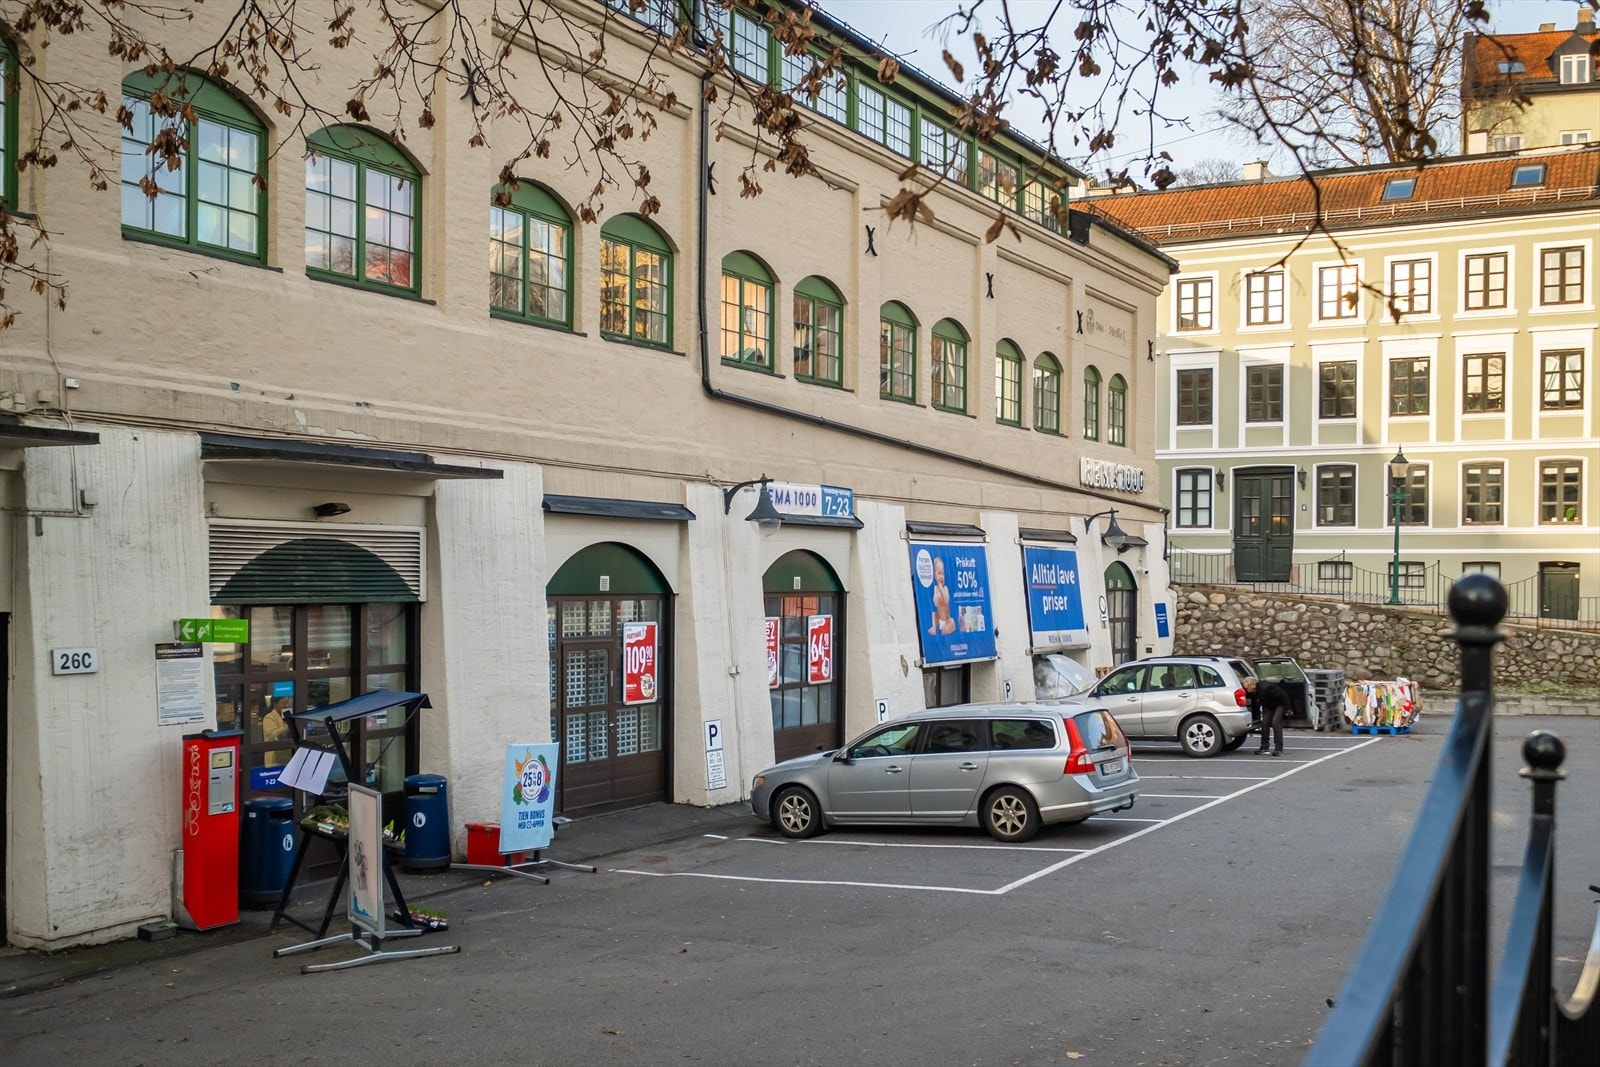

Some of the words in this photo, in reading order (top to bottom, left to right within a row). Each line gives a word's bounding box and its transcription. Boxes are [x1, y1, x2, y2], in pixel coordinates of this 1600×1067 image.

[768, 488, 791, 506] EMA
[794, 491, 817, 506] 1000
[825, 496, 849, 516] 7-23
[955, 557, 976, 567] Priskutt
[957, 571, 978, 589] 50%
[1032, 563, 1056, 584] Alltid
[1057, 565, 1075, 584] lave
[1042, 590, 1068, 615] priser
[811, 633, 825, 662] 64
[60, 652, 92, 670] 26C
[626, 646, 646, 674] 109
[1005, 683, 1011, 699] P
[879, 703, 886, 721] P
[709, 724, 718, 747] P
[523, 772, 533, 787] 25
[536, 771, 542, 787] 8
[530, 809, 545, 819] BONUS
